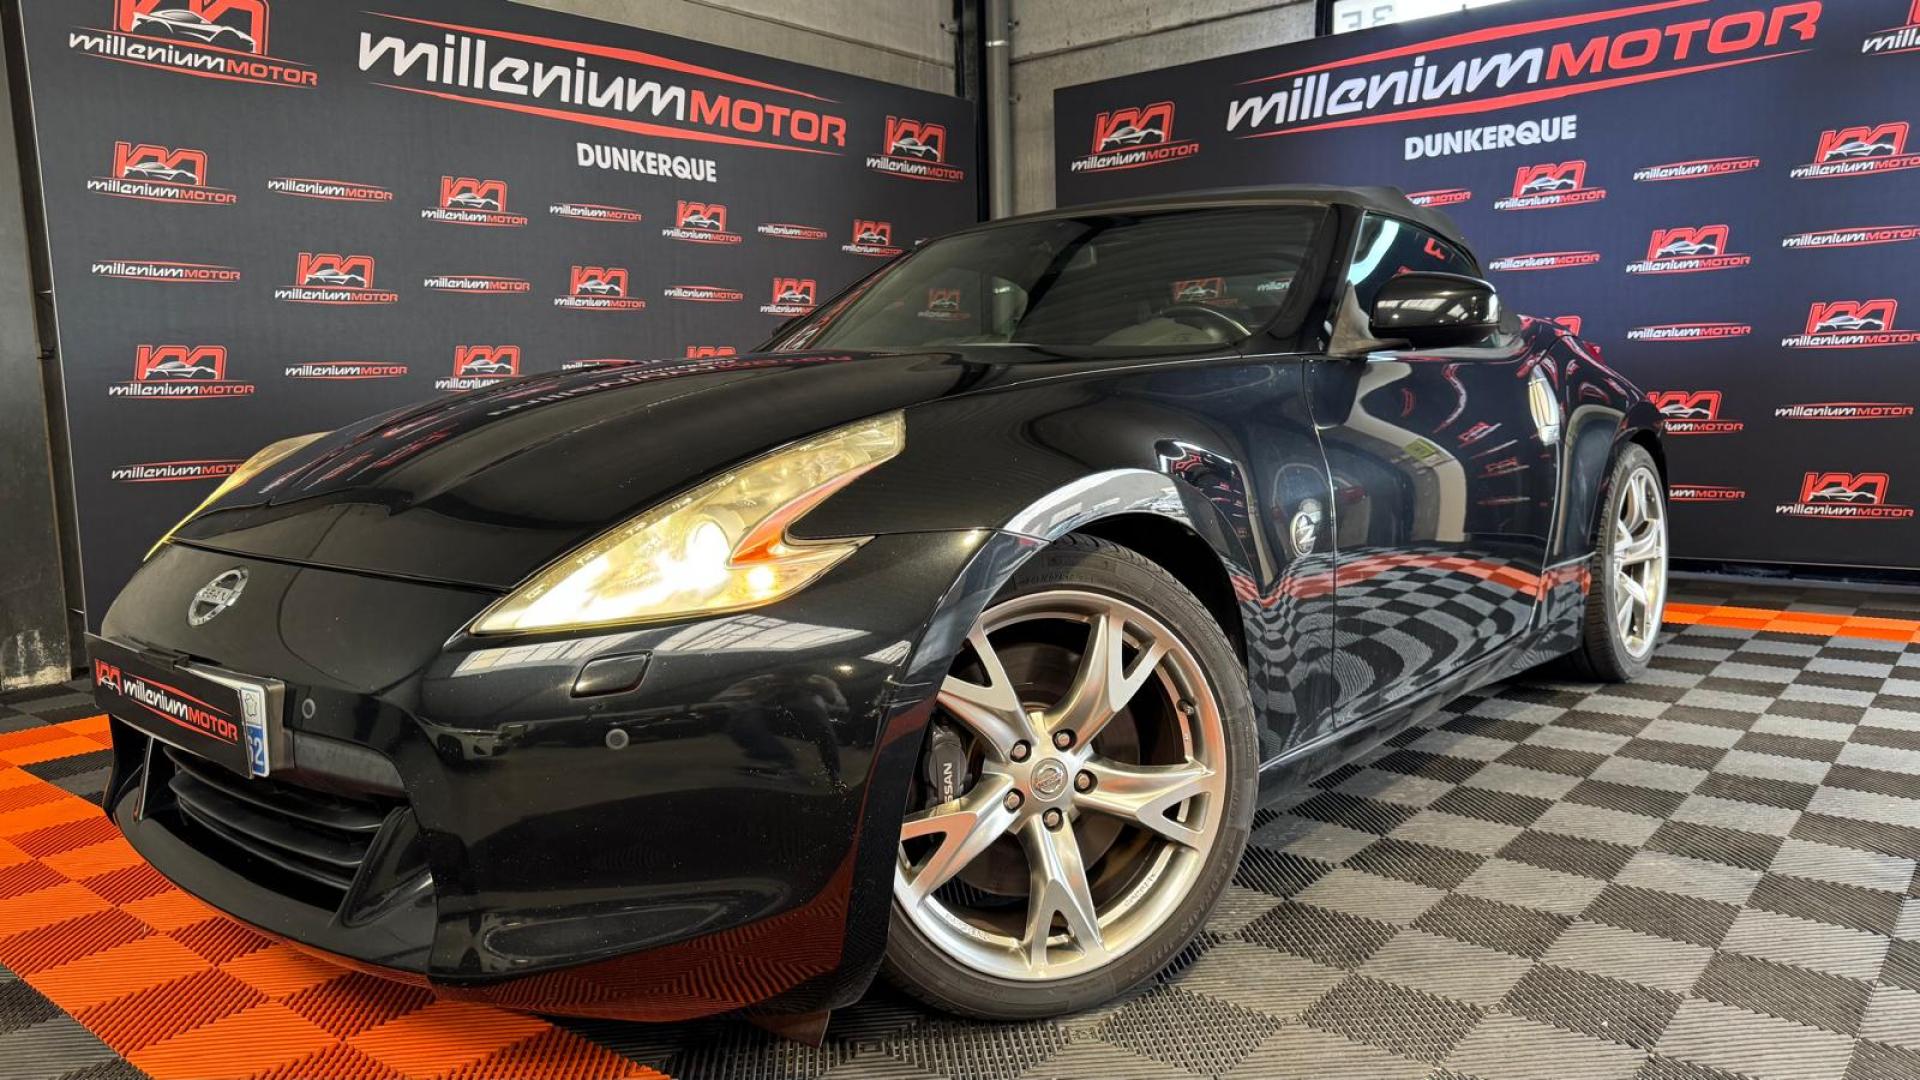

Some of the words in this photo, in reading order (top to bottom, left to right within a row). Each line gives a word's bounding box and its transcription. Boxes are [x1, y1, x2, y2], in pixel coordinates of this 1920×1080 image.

[1404, 115, 1578, 161] DUNKERQUE
[576, 142, 718, 183] DUNKERQUE
[1790, 155, 1920, 179] milleniumMOTO
